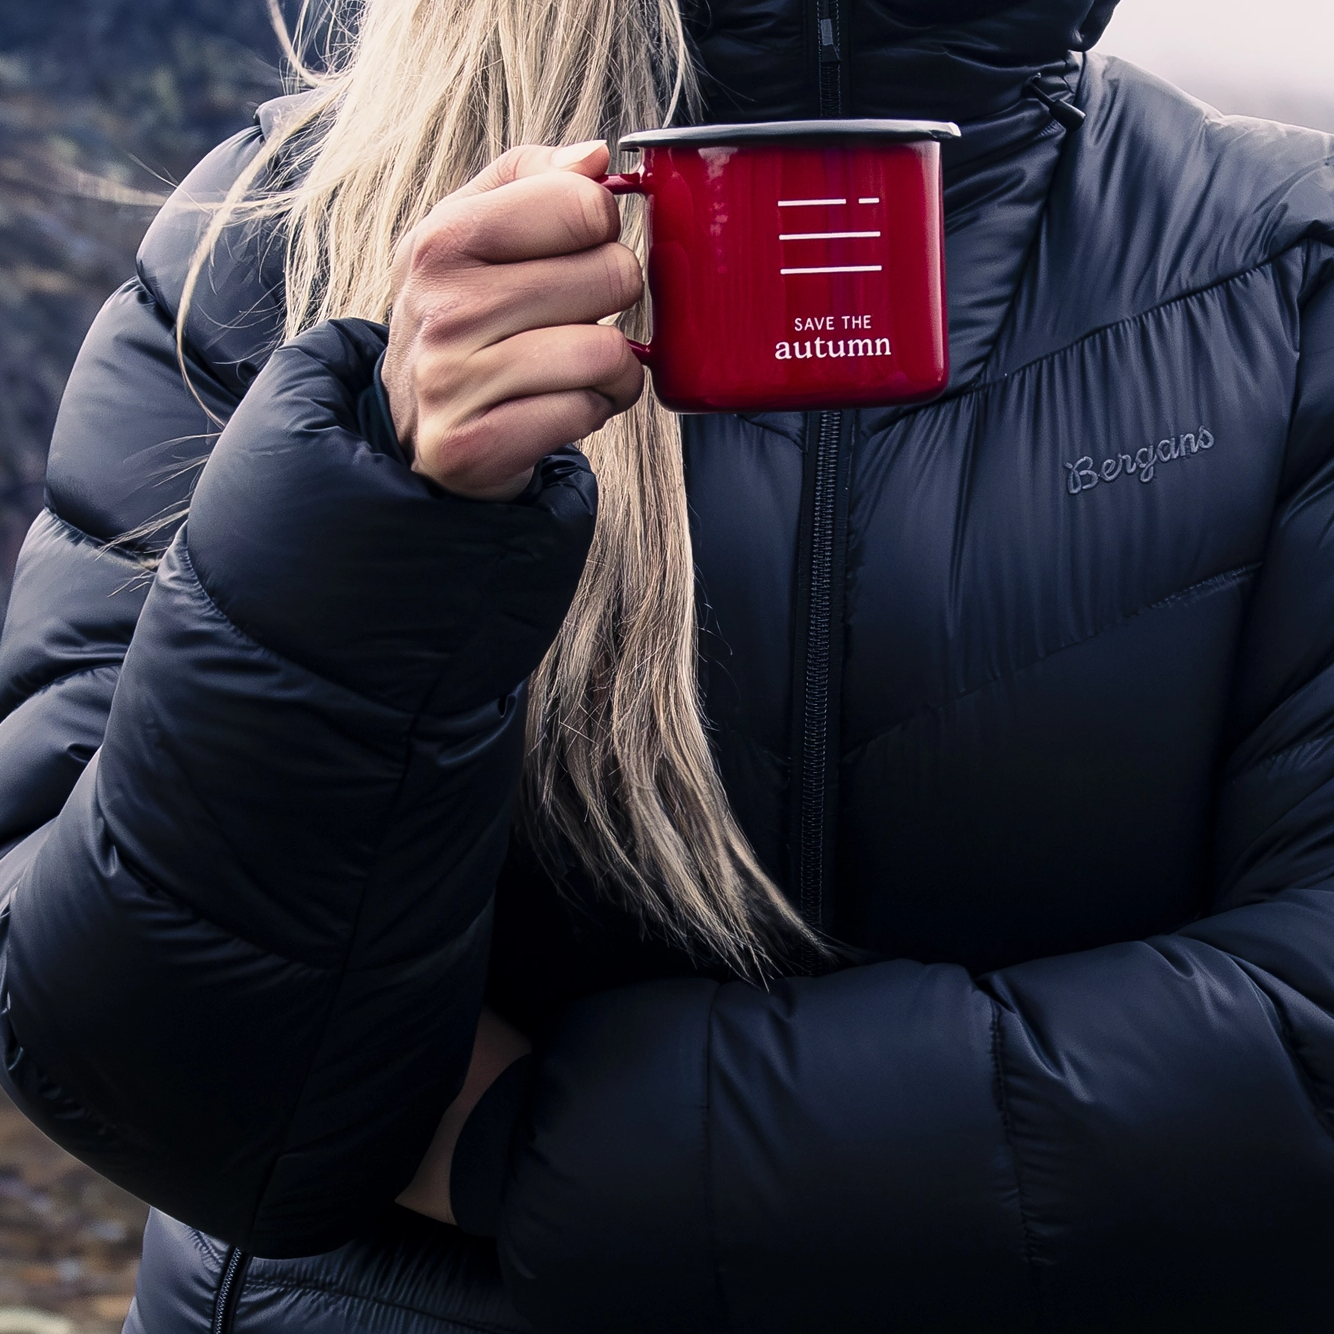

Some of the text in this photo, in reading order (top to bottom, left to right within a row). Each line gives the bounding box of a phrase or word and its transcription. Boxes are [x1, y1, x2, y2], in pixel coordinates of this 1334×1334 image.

[794, 315, 872, 331] SAVE THE
[774, 336, 892, 360] autumn
[1064, 425, 1215, 494] Bergans
